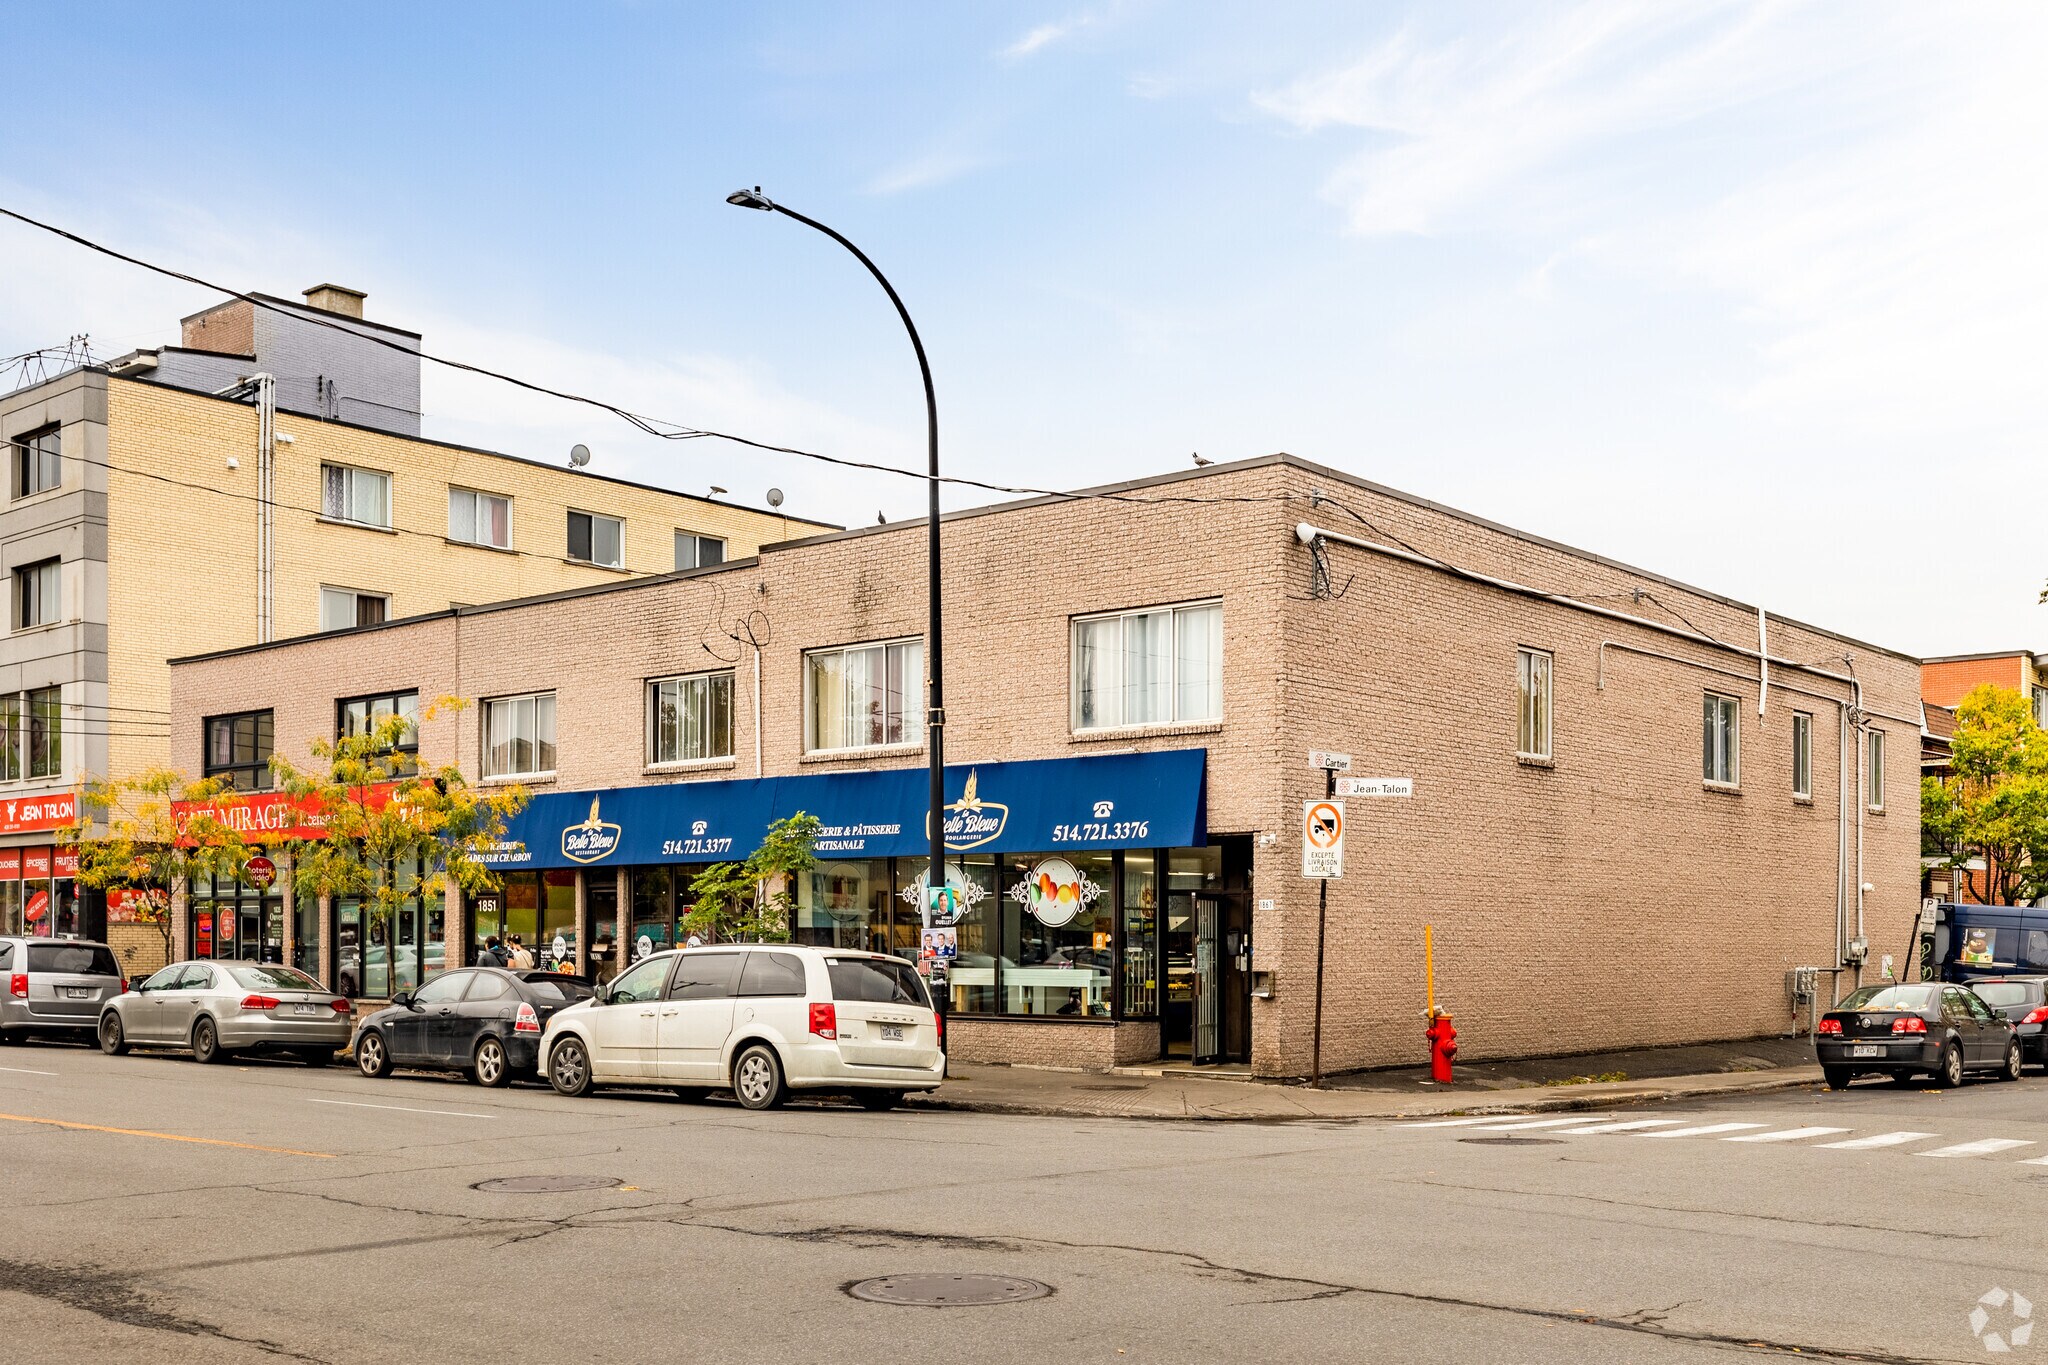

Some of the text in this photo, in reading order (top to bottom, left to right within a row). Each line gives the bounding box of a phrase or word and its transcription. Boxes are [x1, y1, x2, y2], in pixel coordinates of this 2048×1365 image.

[1325, 757, 1348, 769] Cartier
[1353, 784, 1408, 794] Jean-Talon
[20, 804, 42, 821] JEAN
[44, 802, 74, 819] TALON
[220, 803, 289, 832] MIRAGE
[843, 827, 851, 837] &
[852, 822, 900, 836] PÂTISSERIE
[963, 814, 999, 834] Bleue
[1052, 820, 1150, 842] 514.721.3376
[566, 832, 614, 851] Belle Bleue
[661, 837, 732, 855] 514.721.3377
[813, 839, 865, 851] ARTISANALE
[55, 857, 73, 867] FRUITS
[486, 853, 499, 862] SUR
[499, 852, 532, 863] CHARBON
[1308, 858, 1338, 866] LIVRAISON
[477, 899, 497, 912] 1851
[1260, 901, 1273, 909] 1867
[1926, 900, 1934, 909] P
